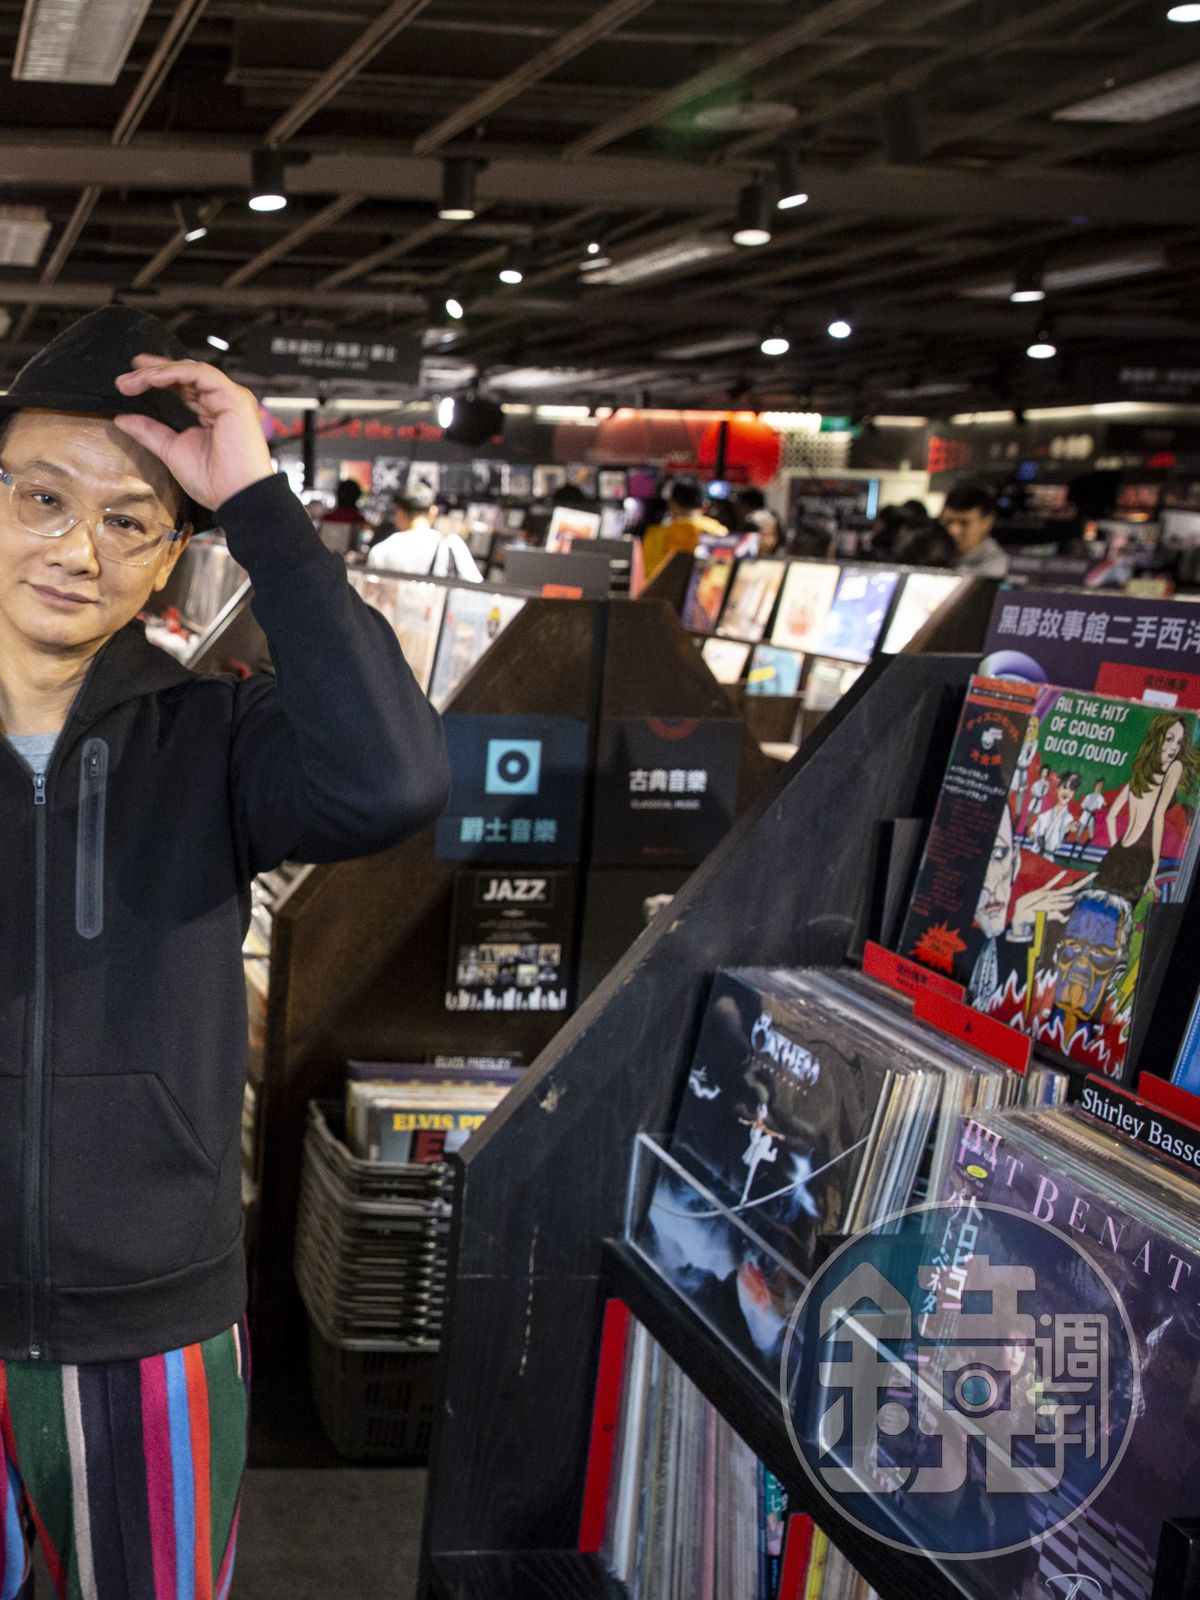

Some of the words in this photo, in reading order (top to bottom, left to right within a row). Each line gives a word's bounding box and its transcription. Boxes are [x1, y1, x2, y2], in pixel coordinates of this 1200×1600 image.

[1055, 696, 1074, 714] ALL
[1076, 699, 1100, 718] THE
[1100, 704, 1130, 723] HITS
[1050, 716, 1068, 732] OF
[1068, 719, 1116, 742] GOLDEN
[1044, 735, 1079, 756] DISCO
[1078, 743, 1129, 766] SOUNDS
[629, 769, 707, 793] 古典音樂
[460, 817, 557, 843] 爵士音樂
[483, 879, 547, 901] JAZZ
[393, 1113, 455, 1132] ELVIS
[1082, 1088, 1145, 1139] Shirley
[1032, 1174, 1192, 1293] BENAT
